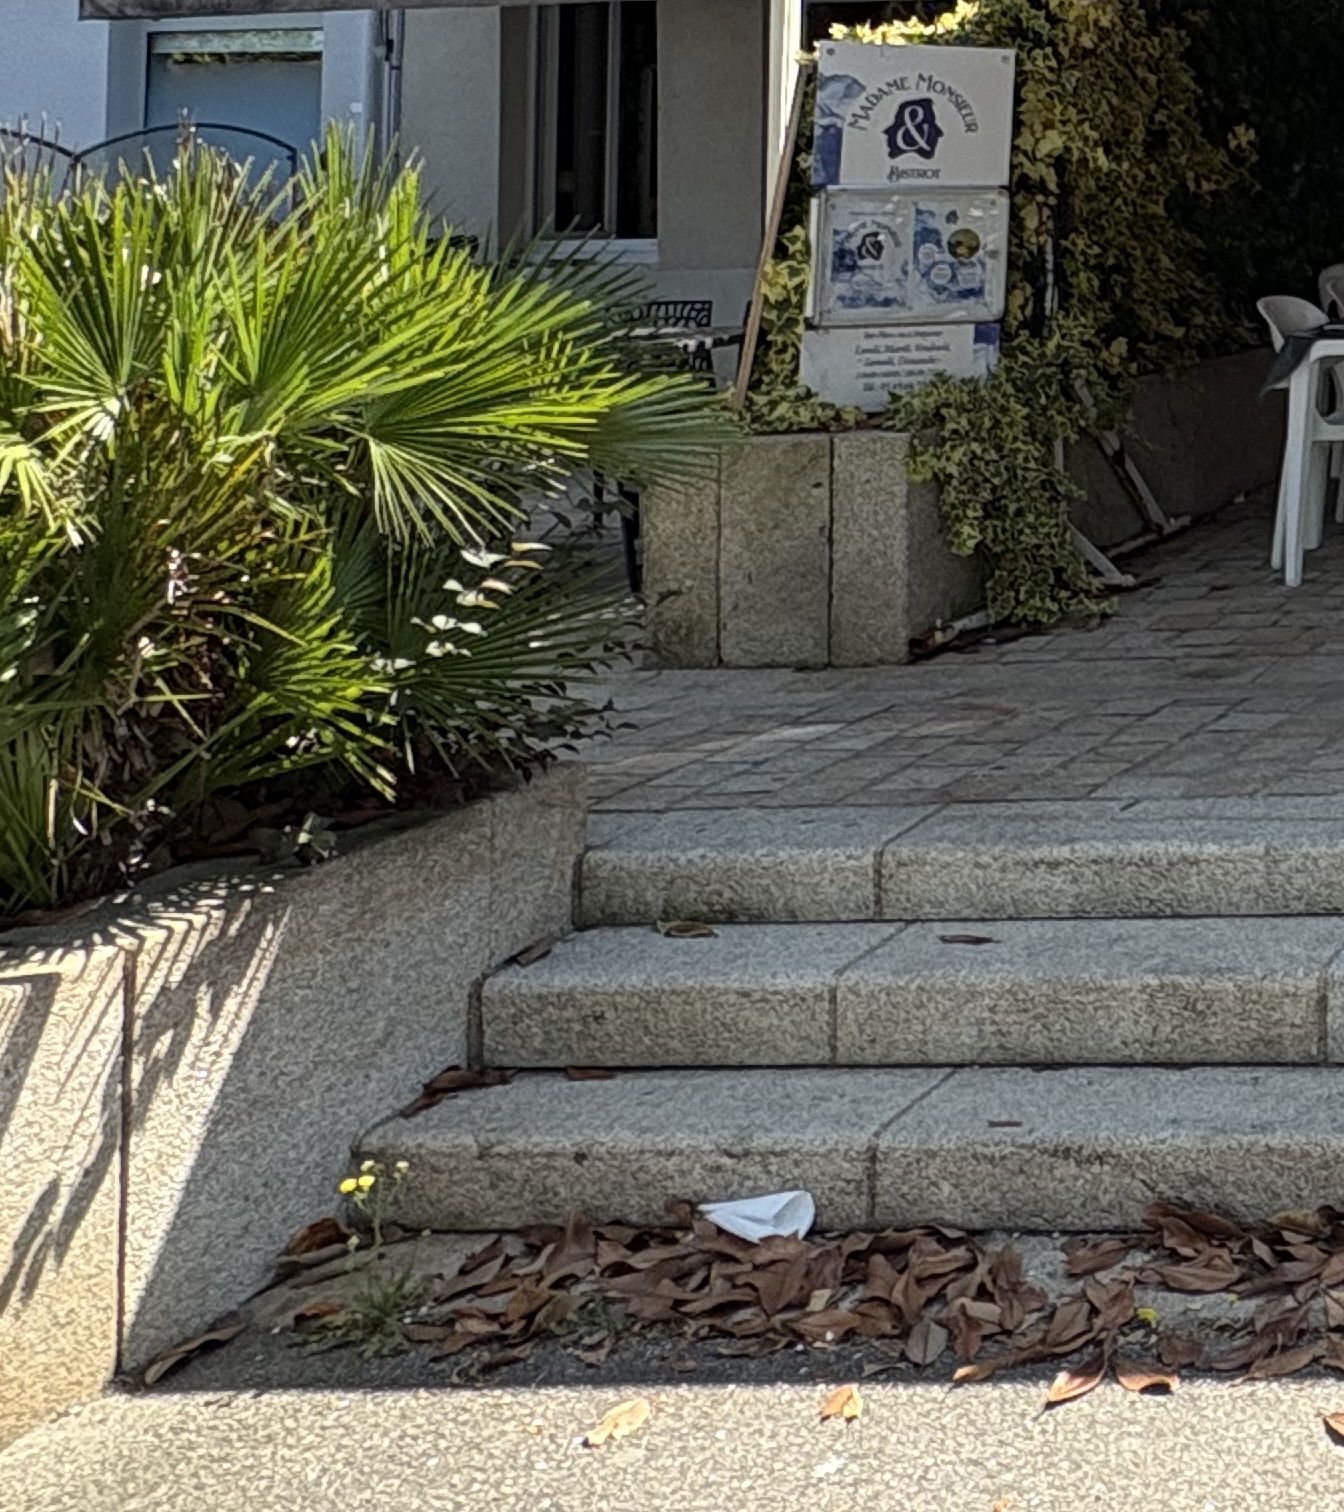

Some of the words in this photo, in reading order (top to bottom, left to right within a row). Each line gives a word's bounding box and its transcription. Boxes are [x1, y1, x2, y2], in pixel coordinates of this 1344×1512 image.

[847, 76, 912, 132] MADAME
[915, 72, 980, 134] MONSIEUR
[896, 104, 932, 152] &
[887, 165, 942, 183] BISTROT
